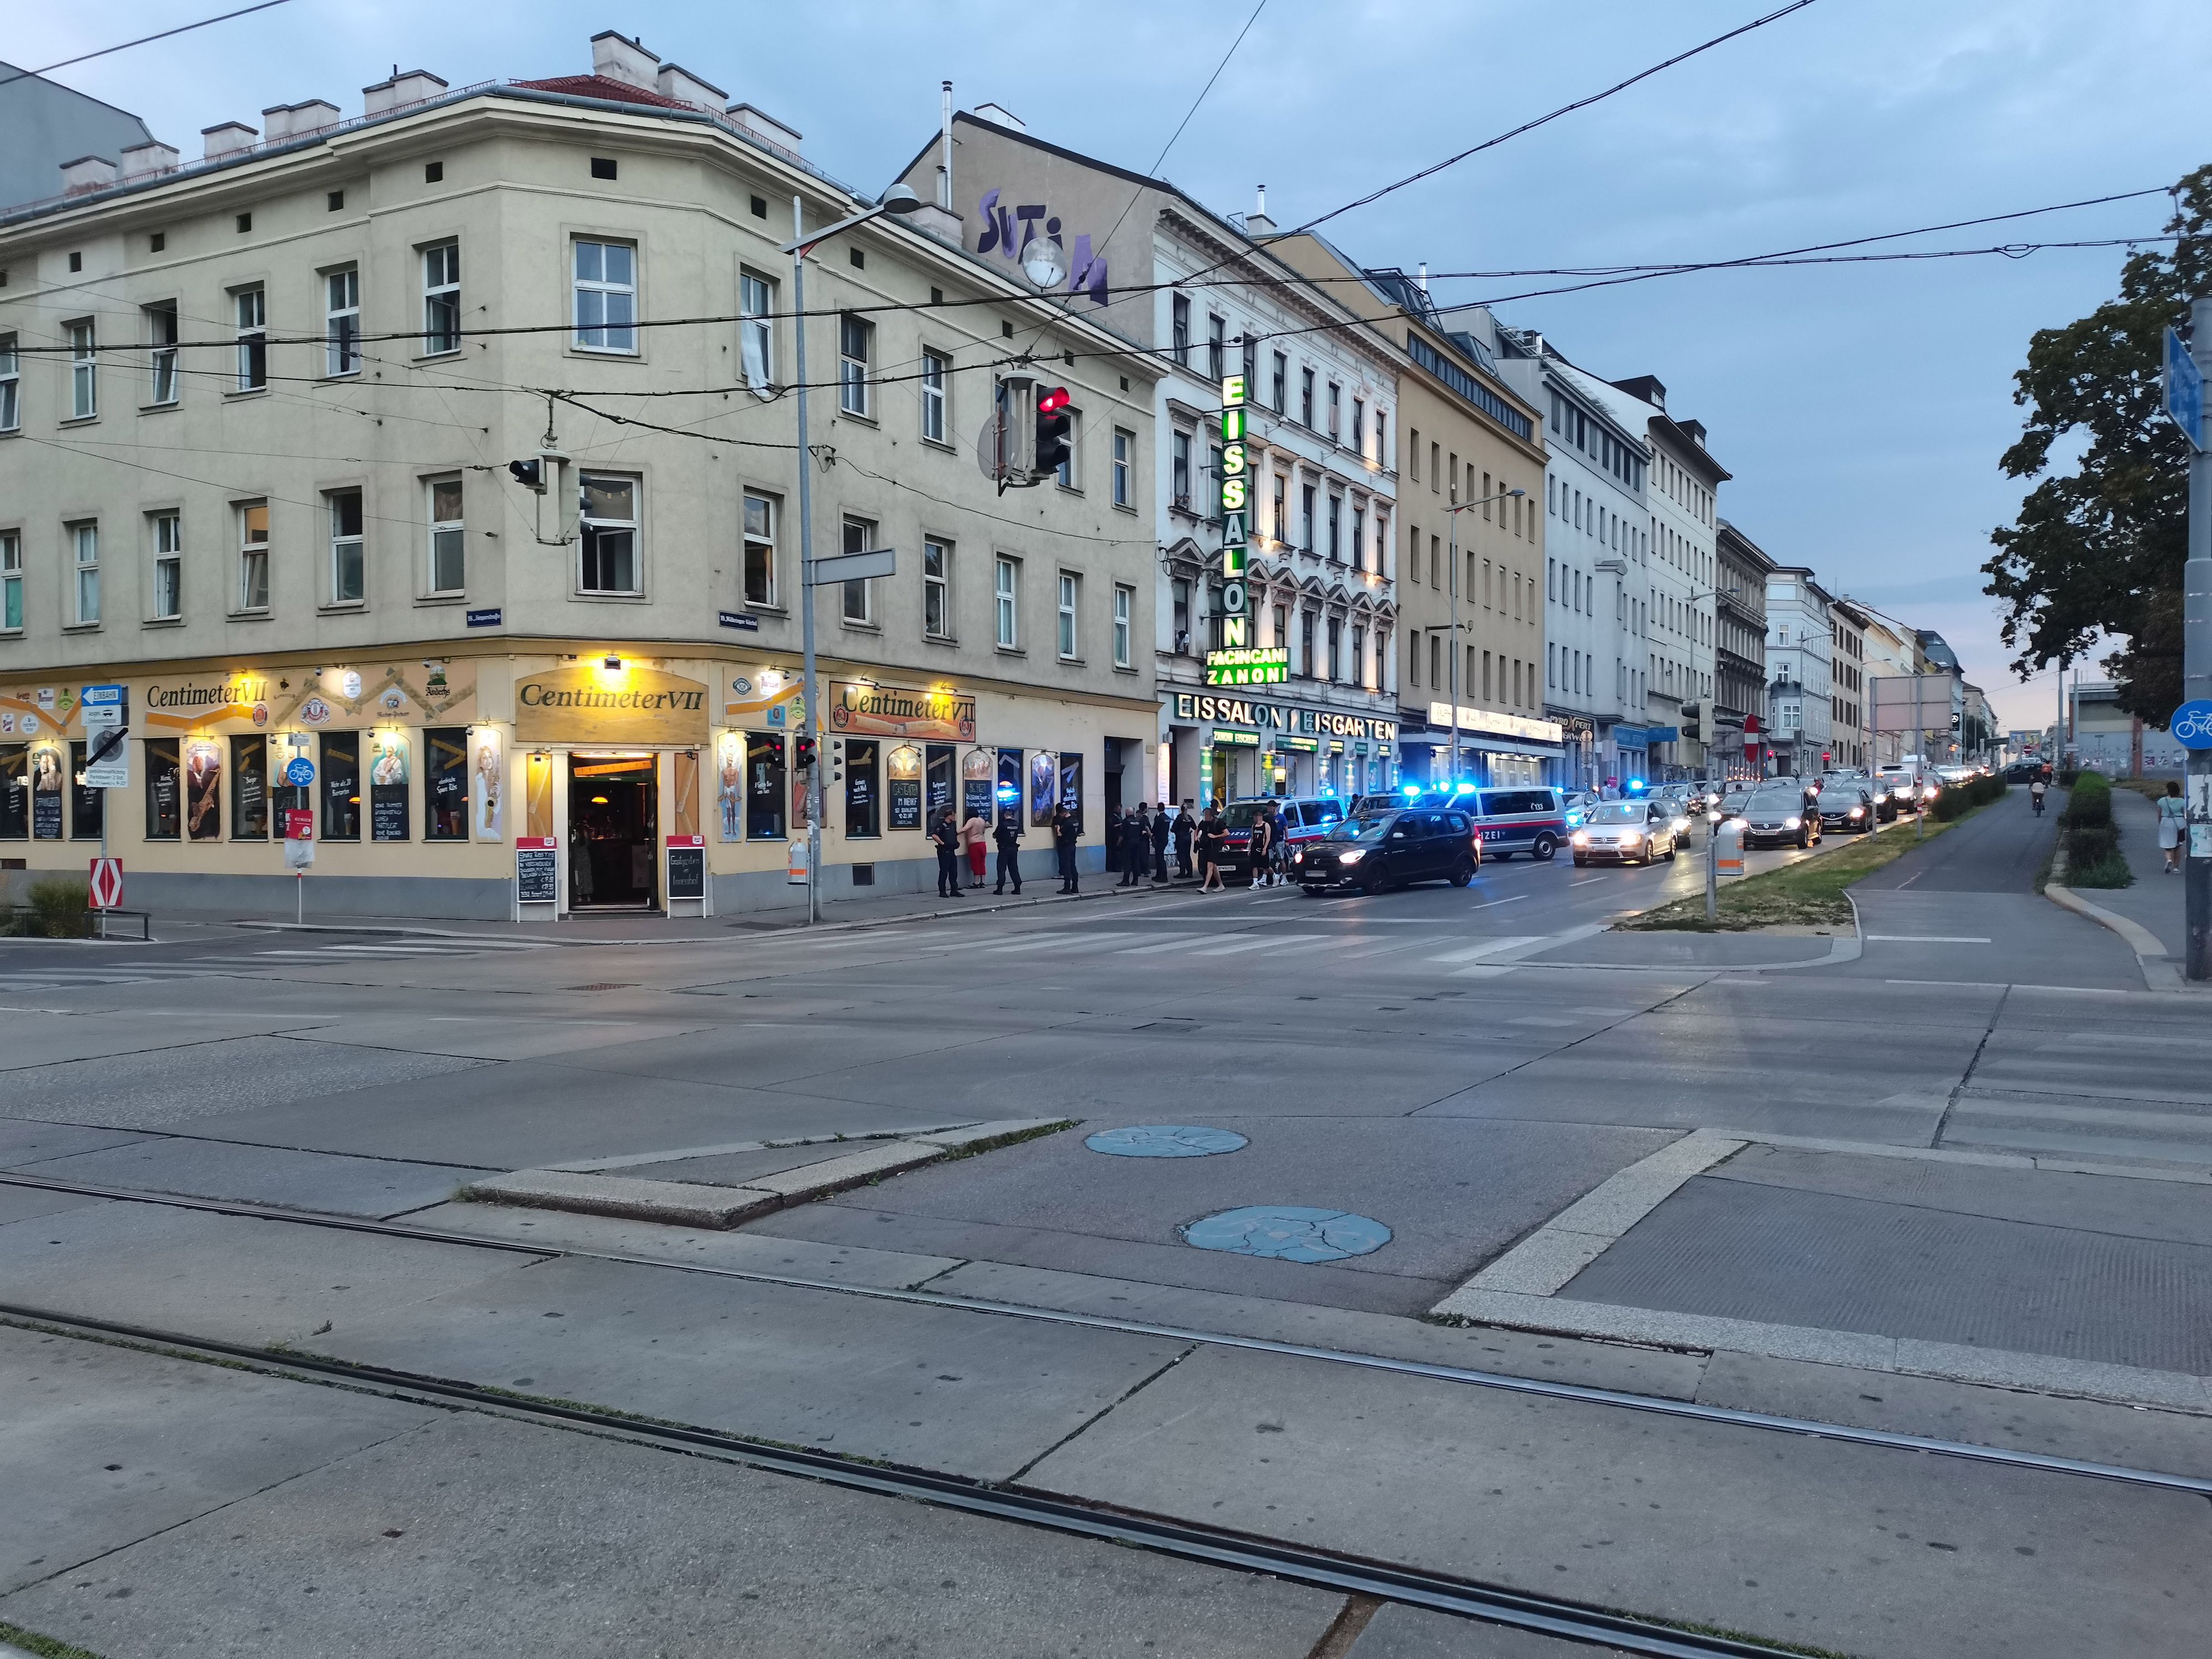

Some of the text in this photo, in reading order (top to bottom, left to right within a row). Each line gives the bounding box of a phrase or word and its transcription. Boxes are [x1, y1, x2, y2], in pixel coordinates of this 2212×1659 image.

[1223, 376, 1244, 647] EISSALON
[1207, 648, 1287, 666] FACINCANI
[1207, 666, 1287, 685] ZANONI
[94, 691, 117, 700] EINBAHN
[1178, 694, 1395, 740] EISSALON EISGARTEN
[1481, 831, 1500, 839] IZEI
